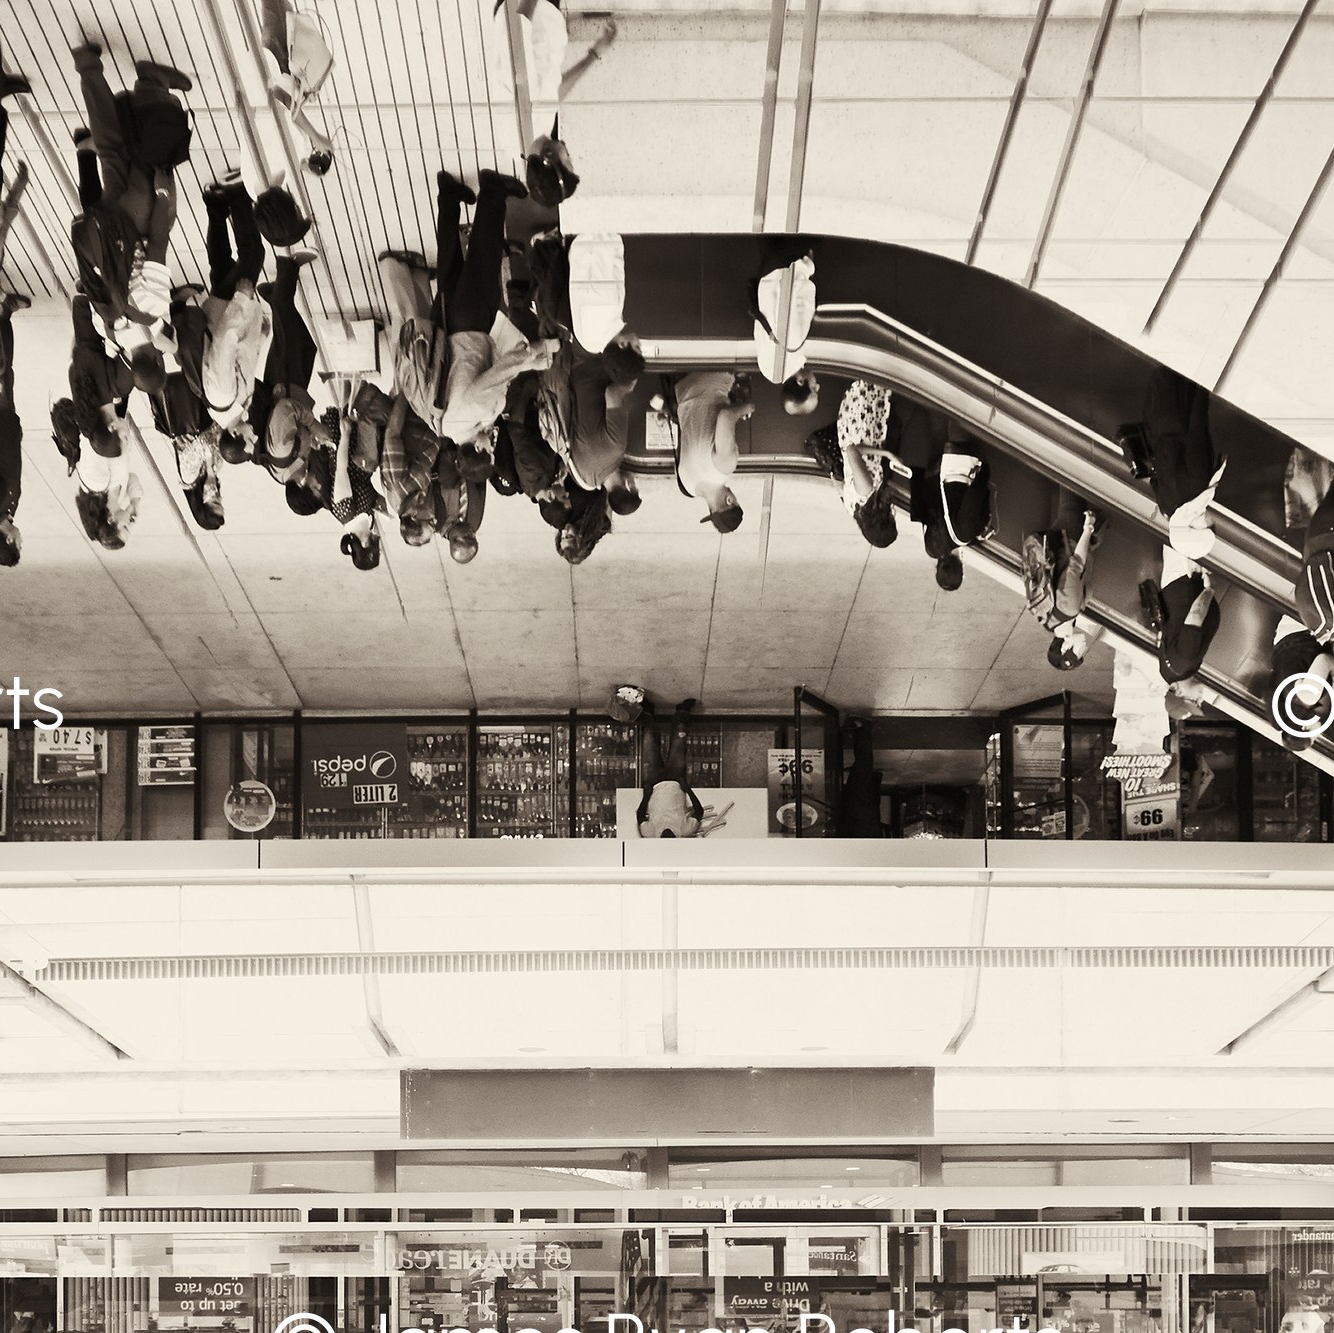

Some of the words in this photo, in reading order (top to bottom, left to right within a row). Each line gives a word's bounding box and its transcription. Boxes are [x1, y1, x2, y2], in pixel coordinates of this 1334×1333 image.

[313, 755, 367, 776] pepsi
[1099, 755, 1172, 770] SMOOTHIES!
[1106, 767, 1130, 779] NEW
[1130, 767, 1164, 779] GREAT
[1124, 777, 1142, 791] 10
[354, 786, 385, 803] LITER
[388, 785, 397, 801] 2
[764, 1282, 773, 1292] a
[776, 1281, 809, 1295] with
[180, 1299, 195, 1312] to
[198, 1297, 216, 1311] up
